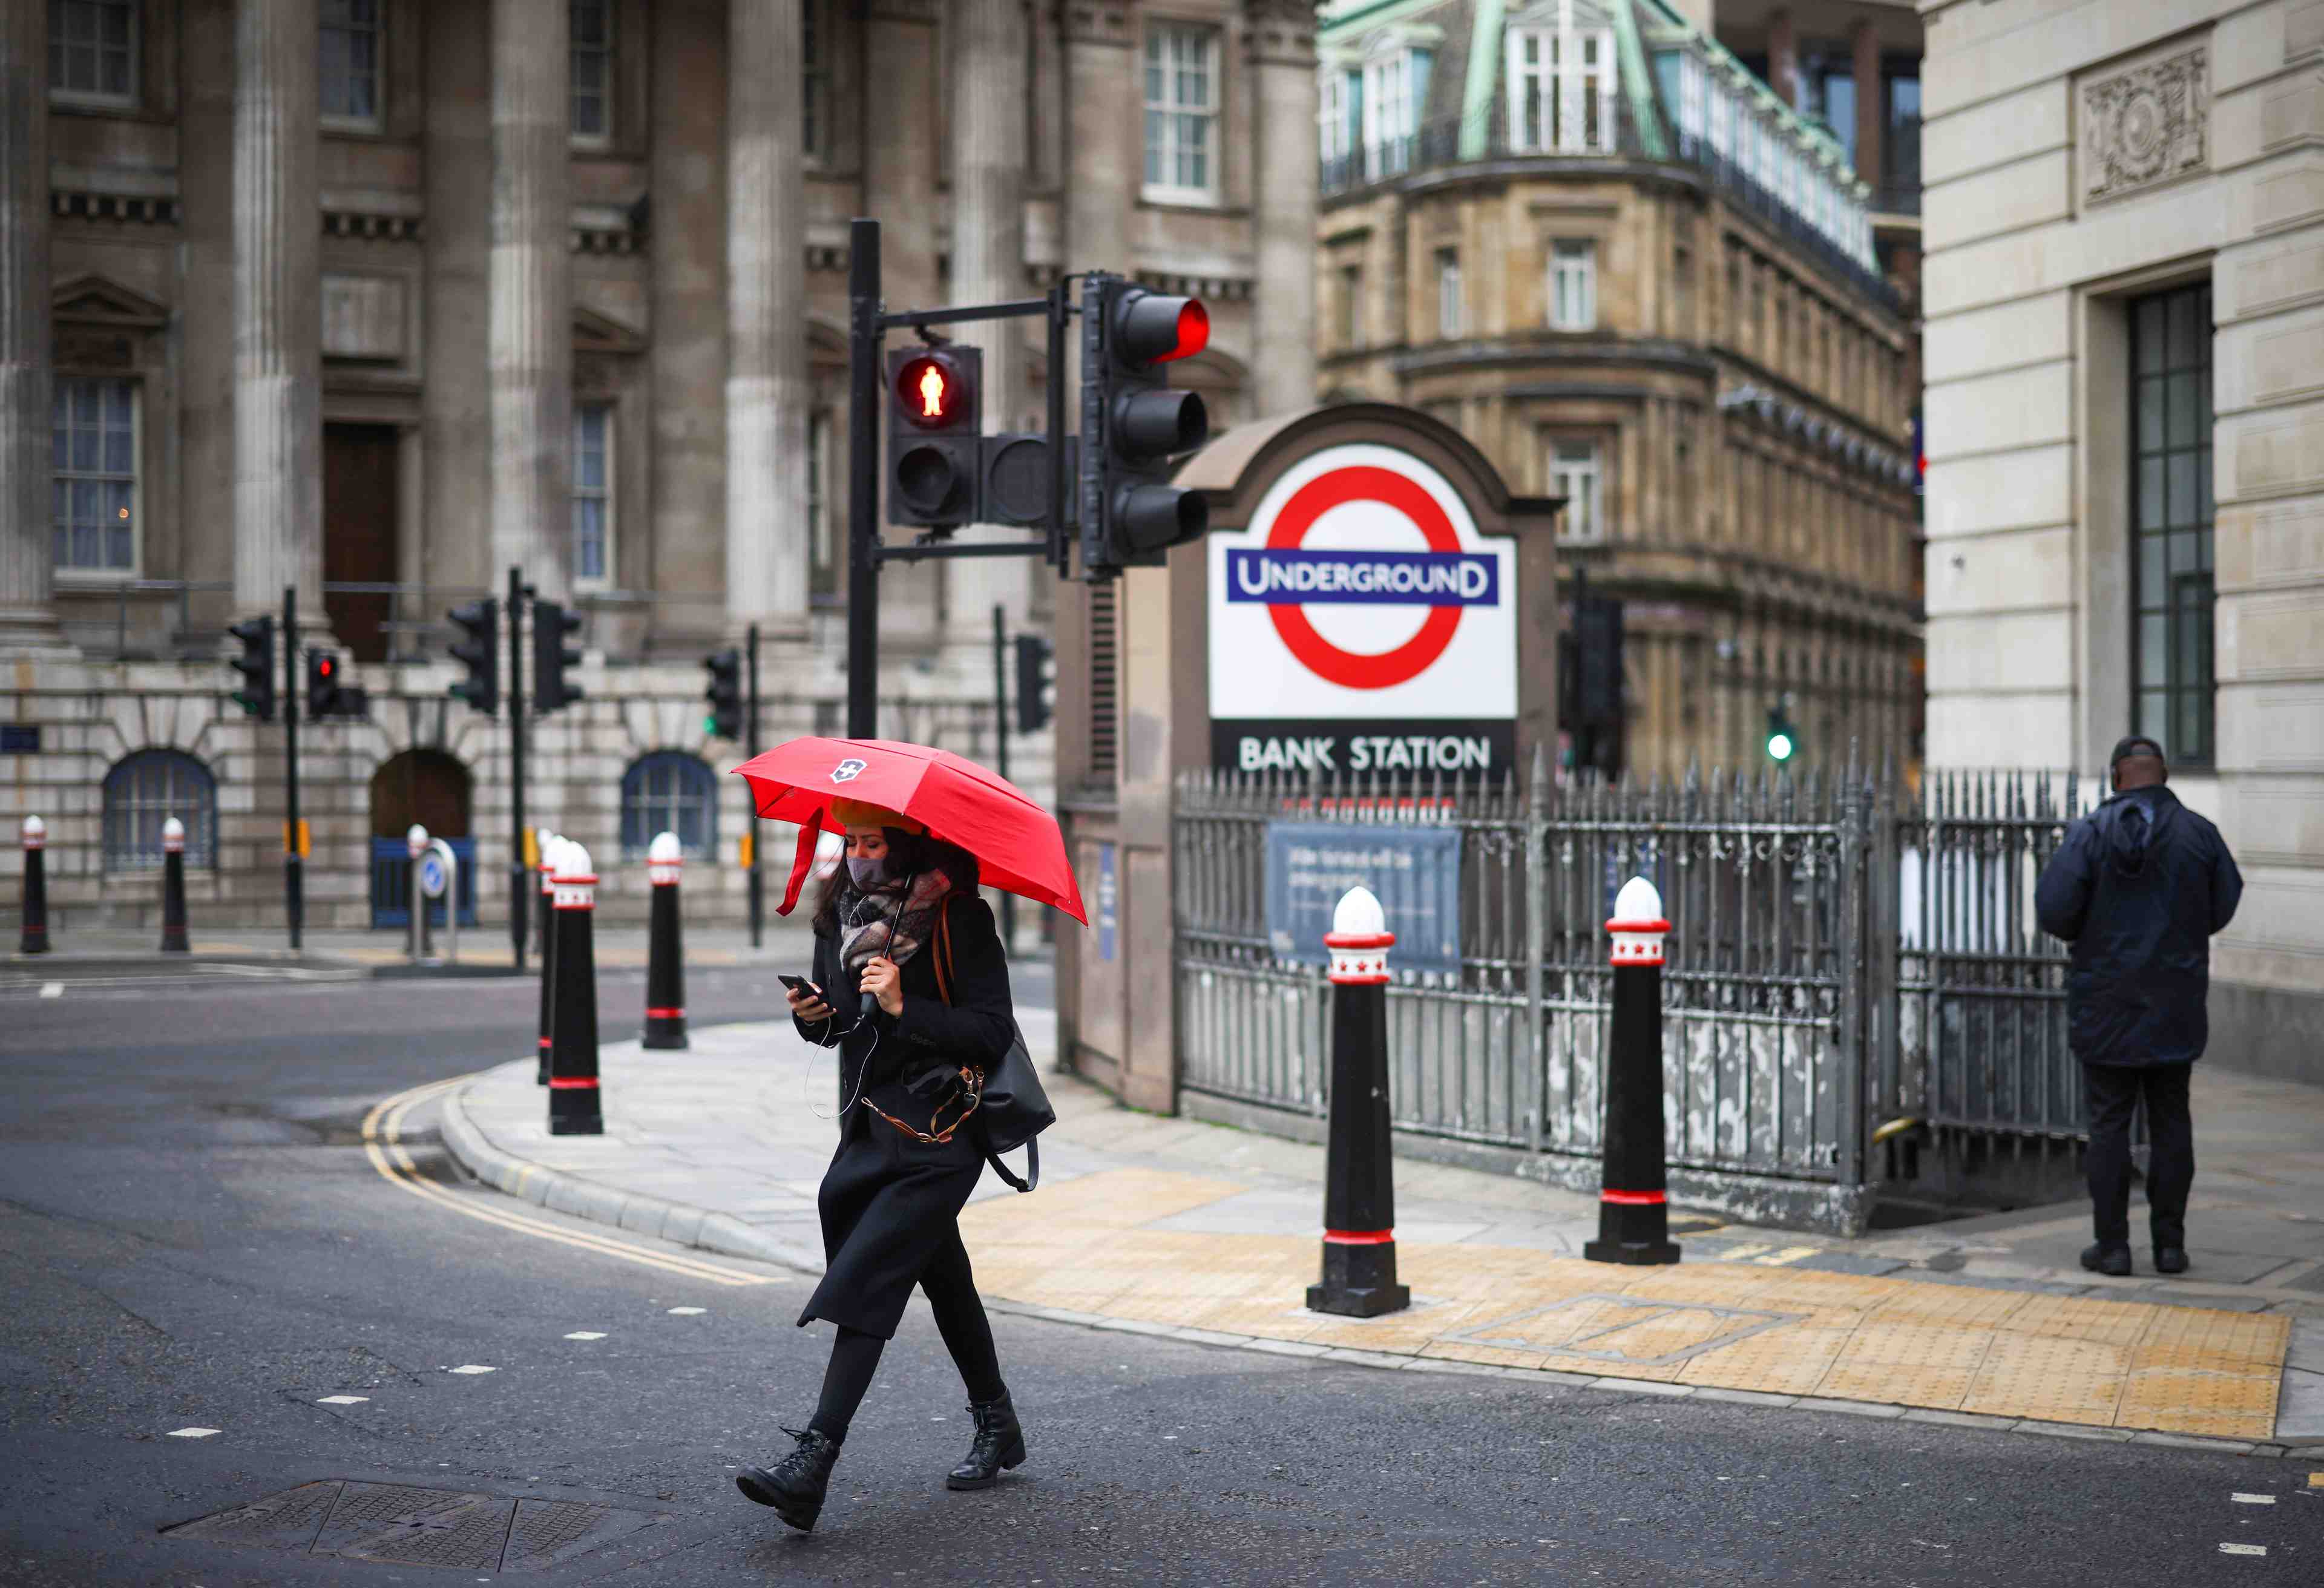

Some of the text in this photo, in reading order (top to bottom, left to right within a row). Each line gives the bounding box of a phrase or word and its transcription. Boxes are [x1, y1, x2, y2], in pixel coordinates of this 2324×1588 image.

[1238, 557, 1489, 598] UNDERGROUND
[1239, 735, 1490, 770] BANK STATION
